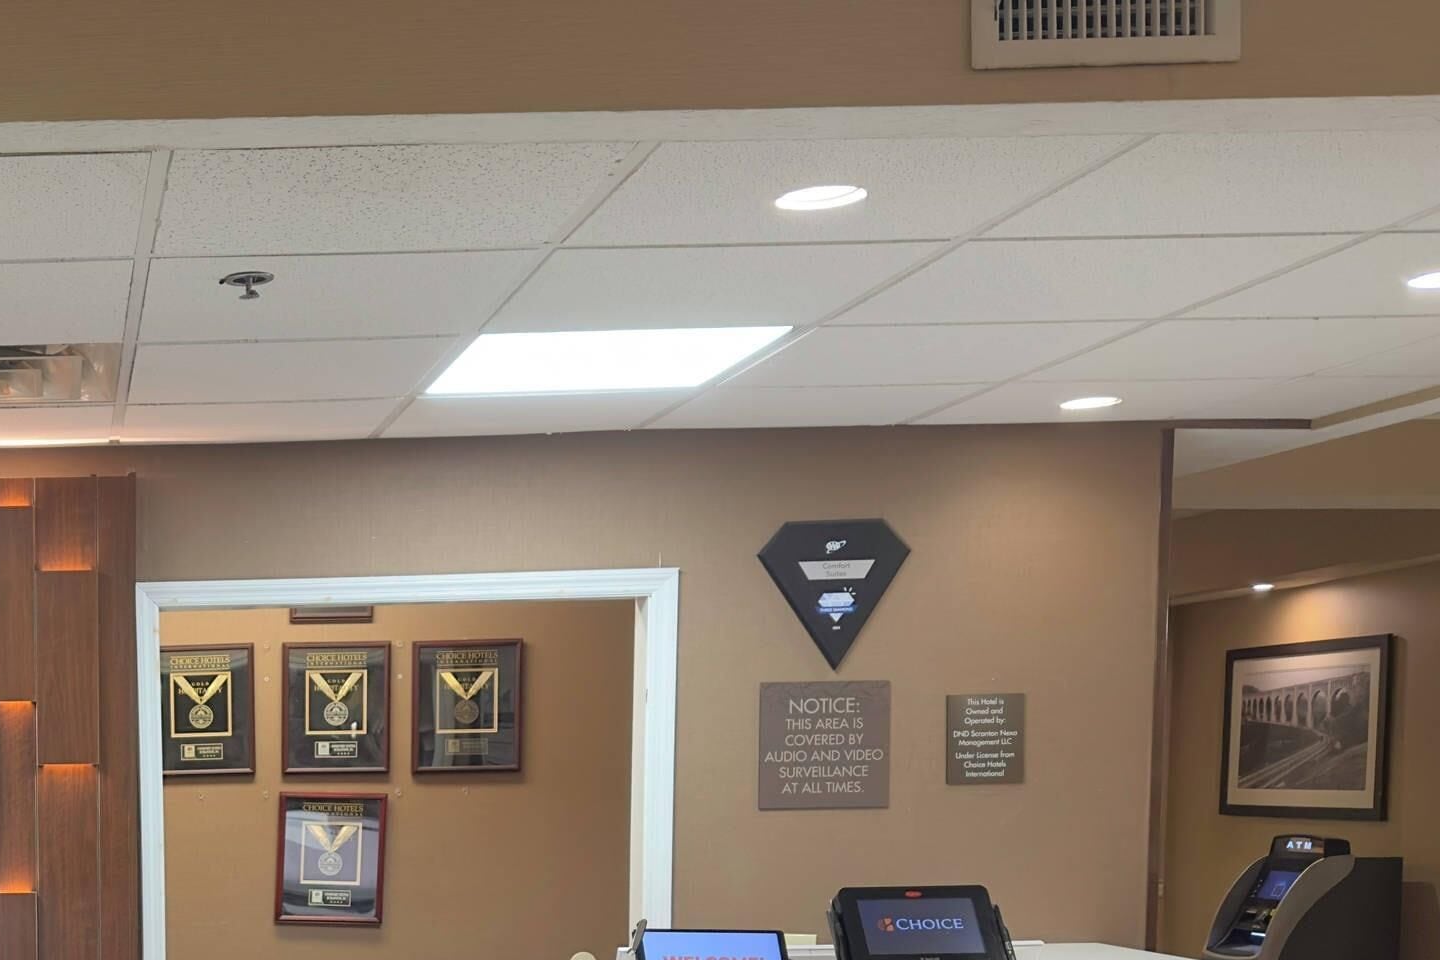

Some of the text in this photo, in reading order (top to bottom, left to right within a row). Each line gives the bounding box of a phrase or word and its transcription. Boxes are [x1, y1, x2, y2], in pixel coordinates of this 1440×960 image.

[789, 697, 860, 714] NOTICE:
[786, 717, 864, 730] THIS AREA IS
[964, 717, 994, 725] Operated
[785, 734, 864, 746] COVERED BY
[958, 739, 999, 747] Management
[764, 749, 884, 762] AUDIO AND VIDEO
[779, 765, 869, 778] SURVEILLANCE
[782, 781, 864, 794] AT ALL TIMES.
[1286, 841, 1312, 849] ATM
[896, 918, 964, 930] CHOICE
